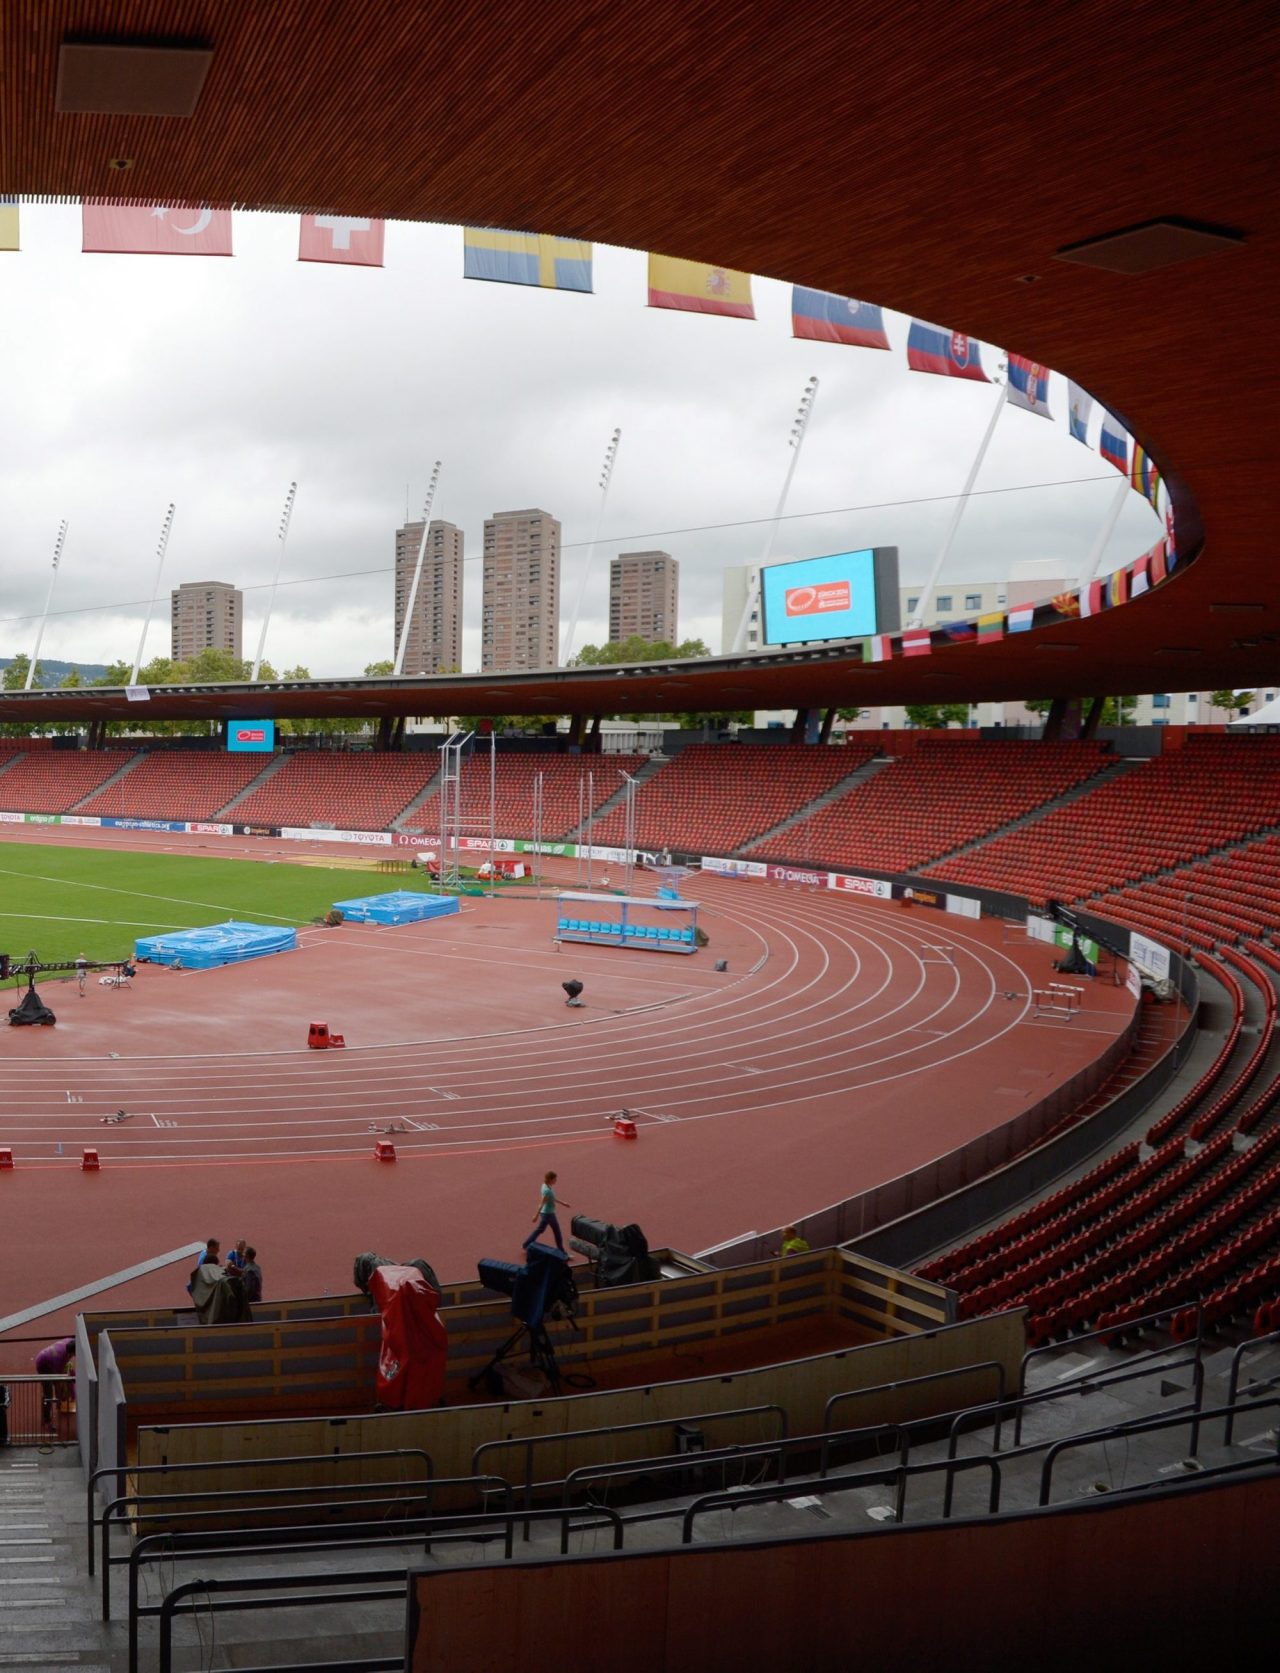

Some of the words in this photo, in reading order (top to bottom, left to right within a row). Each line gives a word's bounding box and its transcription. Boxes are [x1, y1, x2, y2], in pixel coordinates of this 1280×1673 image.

[353, 833, 385, 843] TOYOTA
[410, 836, 442, 846] OMEGA
[843, 878, 874, 893] SPAR
